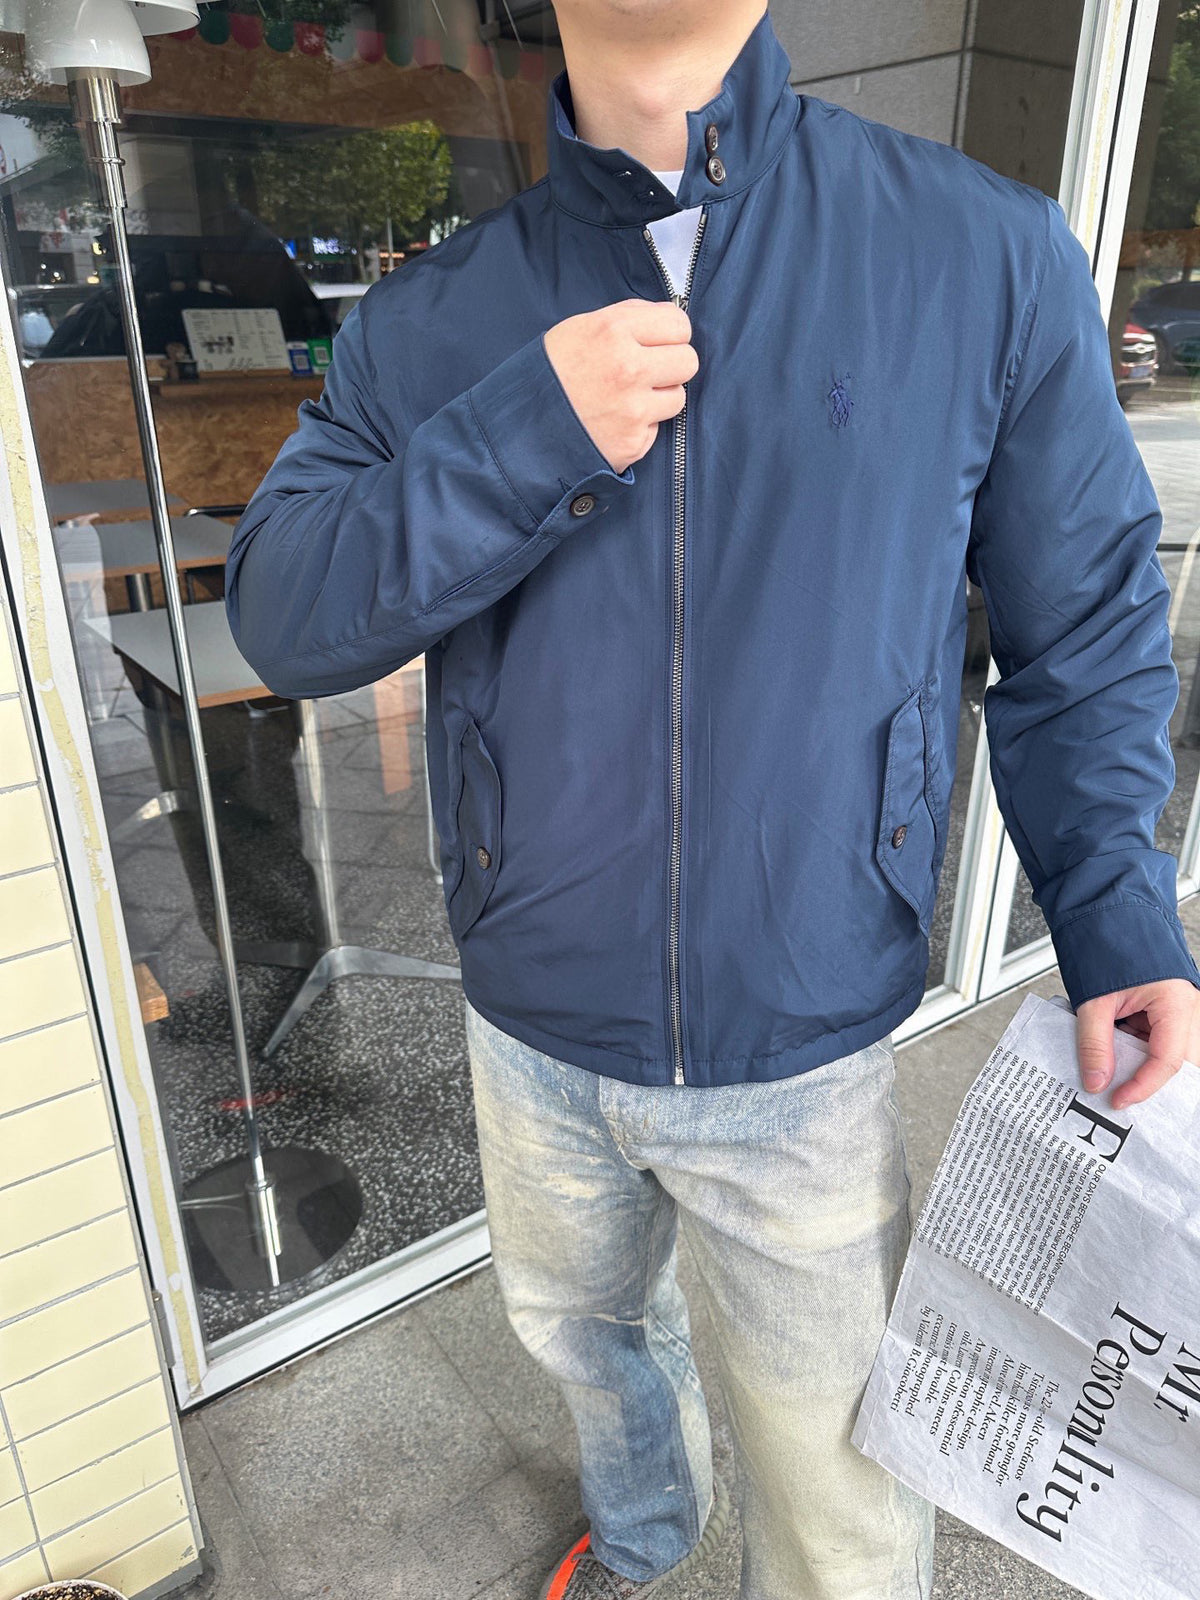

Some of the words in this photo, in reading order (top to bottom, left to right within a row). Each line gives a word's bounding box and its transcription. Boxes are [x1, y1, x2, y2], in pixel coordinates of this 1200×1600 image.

[1009, 1054, 1020, 1067] ate
[999, 1066, 1013, 1085] some
[1013, 1060, 1028, 1082] called
[980, 1082, 991, 1095] set
[1008, 1080, 1018, 1092] for
[1012, 1065, 1038, 1103] der-length
[1046, 1076, 1056, 1090] sor
[1053, 1082, 1065, 1096] was
[975, 1094, 984, 1105] up
[989, 1085, 1003, 1101] kind
[1033, 1089, 1050, 1108] black
[1062, 1087, 1074, 1102] was
[985, 1099, 992, 1109] of
[992, 1096, 1008, 1115] head
[1035, 1096, 1057, 1123] wearing
[1048, 1101, 1065, 1124] gently
[963, 1111, 976, 1136] quartet
[990, 1103, 1014, 1150] sun-streaked
[1062, 1090, 1133, 1164] F
[1006, 1129, 1013, 1138] or
[1025, 1127, 1036, 1143] new
[1033, 1122, 1052, 1149] picking
[1047, 1134, 1060, 1147] like
[959, 1138, 978, 1169] Tsitsipass
[974, 1149, 984, 1160] he
[1021, 1141, 1030, 1155] pair
[1031, 1146, 1039, 1157] up
[1052, 1140, 1068, 1164] looked
[1065, 1145, 1076, 1161] and
[983, 1149, 994, 1166] curls
[1017, 1155, 1025, 1164] of
[1037, 1152, 1050, 1172] Ferris
[1072, 1151, 1086, 1171] sipas
[1082, 1157, 1097, 1175] filled
[975, 1166, 987, 1184] were
[1010, 1162, 1022, 1180] black
[1046, 1162, 1058, 1177] less
[1055, 1159, 1068, 1184] started
[1066, 1170, 1077, 1185] took
[1091, 1163, 1106, 1183] OUR
[1029, 1172, 1040, 1193] wheel
[1041, 1176, 1052, 1189] like
[1077, 1173, 1087, 1185] run
[932, 1179, 950, 1209] Tsitsipas
[954, 1190, 966, 1206] took
[964, 1183, 979, 1208] getting
[990, 1187, 1001, 1202] that
[998, 1179, 1014, 1209] sneakers
[1023, 1191, 1033, 1206] that
[1061, 1184, 1071, 1196] the
[1070, 1191, 1079, 1204] the
[1082, 1181, 1097, 1204] DAYS
[949, 1206, 958, 1218] out
[961, 1207, 969, 1216] in
[982, 1201, 994, 1219] read
[1008, 1198, 1018, 1212] was
[1018, 1204, 1028, 1219] had
[1054, 1195, 1065, 1213] court
[1063, 1202, 1075, 1220] finals
[926, 1209, 935, 1223] was
[956, 1215, 965, 1227] his
[991, 1208, 1003, 1225] from
[1023, 1193, 1044, 1234] 22-year-old
[1051, 1211, 1059, 1221] at
[939, 1221, 951, 1243] pouch
[971, 1219, 987, 1245] TERRE
[1012, 1215, 1023, 1231] just
[1033, 1214, 1046, 1232] arms,
[1060, 1219, 1067, 1228] at
[980, 1224, 995, 1247] Adidas,
[1005, 1229, 1018, 1247] been
[1014, 1232, 1028, 1253] tennis
[1037, 1224, 1053, 1254] suburban
[1050, 1226, 1066, 1250] Roland
[975, 1248, 985, 1259] his
[1021, 1233, 1038, 1261] reaching
[995, 1247, 1009, 1270] turned
[1008, 1252, 1018, 1267] star
[1018, 1260, 1026, 1270] so
[1029, 1253, 1042, 1271] Paris
[991, 1268, 999, 1278] on
[1001, 1266, 1012, 1281] and
[1013, 1269, 1023, 1281] far
[1017, 1270, 1033, 1296] country
[920, 1305, 935, 1317] by
[960, 1330, 972, 1346] oils.
[974, 1337, 986, 1353] An
[954, 1346, 968, 1368] Lauren
[1016, 1362, 1031, 1380] him
[927, 1366, 946, 1403] lovable
[941, 1369, 961, 1405] Collins
[1045, 1380, 1060, 1397] The
[1002, 1394, 1019, 1423] killer
[929, 1405, 944, 1436] meets
[1011, 1412, 1027, 1440] more
[956, 1416, 974, 1450] design.
[985, 1424, 1007, 1474] forehand.
[1016, 1435, 1038, 1481] Stefanos
